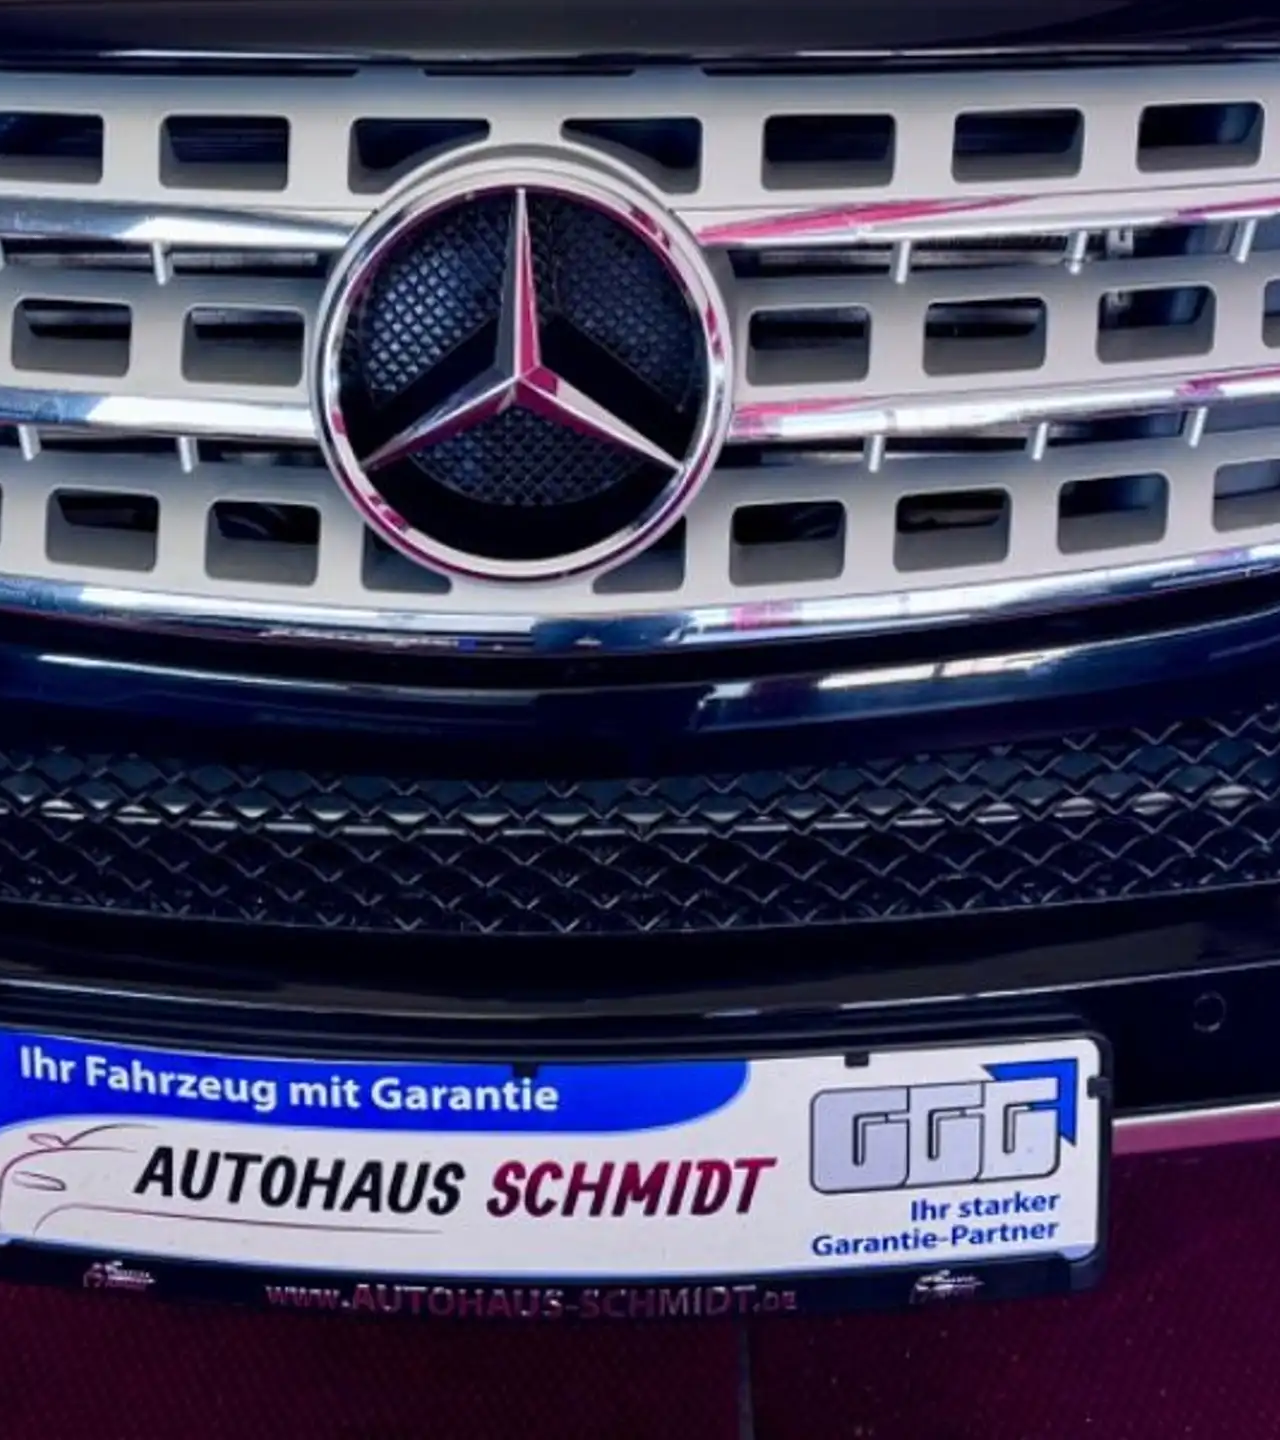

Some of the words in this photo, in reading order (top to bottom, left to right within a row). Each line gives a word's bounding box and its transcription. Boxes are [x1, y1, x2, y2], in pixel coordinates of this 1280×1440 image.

[20, 1045, 76, 1083] Ihr
[85, 1055, 278, 1112] Fahrzeug
[289, 1076, 362, 1109] mit
[370, 1076, 560, 1112] Garantie
[133, 1145, 466, 1216] AUTOHAUS
[486, 1157, 778, 1218] SCHMIDT
[911, 1199, 950, 1222] Ihr
[958, 1191, 1061, 1219] starker
[811, 1218, 1060, 1257] Garantie-Partner
